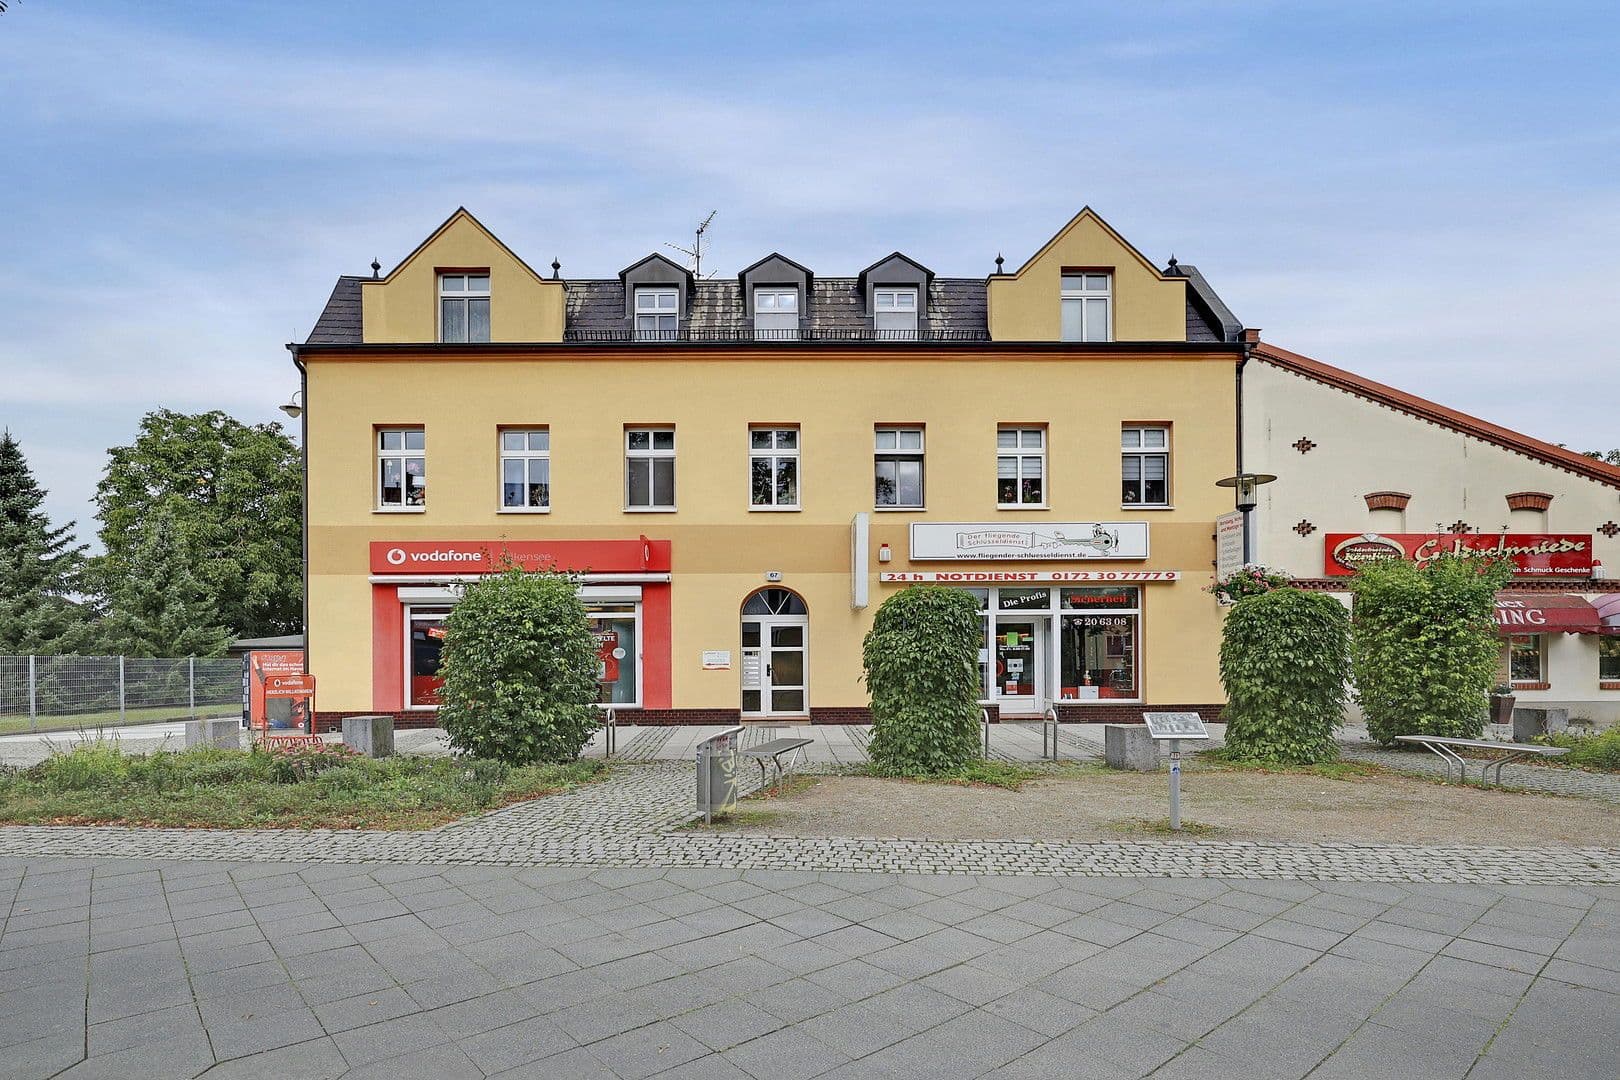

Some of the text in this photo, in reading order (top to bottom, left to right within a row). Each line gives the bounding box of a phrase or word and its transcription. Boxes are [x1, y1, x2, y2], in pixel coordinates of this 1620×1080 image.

[984, 533, 1020, 541] fliegende
[410, 550, 482, 562] vodafone
[1051, 572, 1091, 580] 0172
[1096, 572, 1117, 580] 30
[1003, 591, 1047, 608] Die Profis
[1084, 617, 1127, 626] 20 63 08
